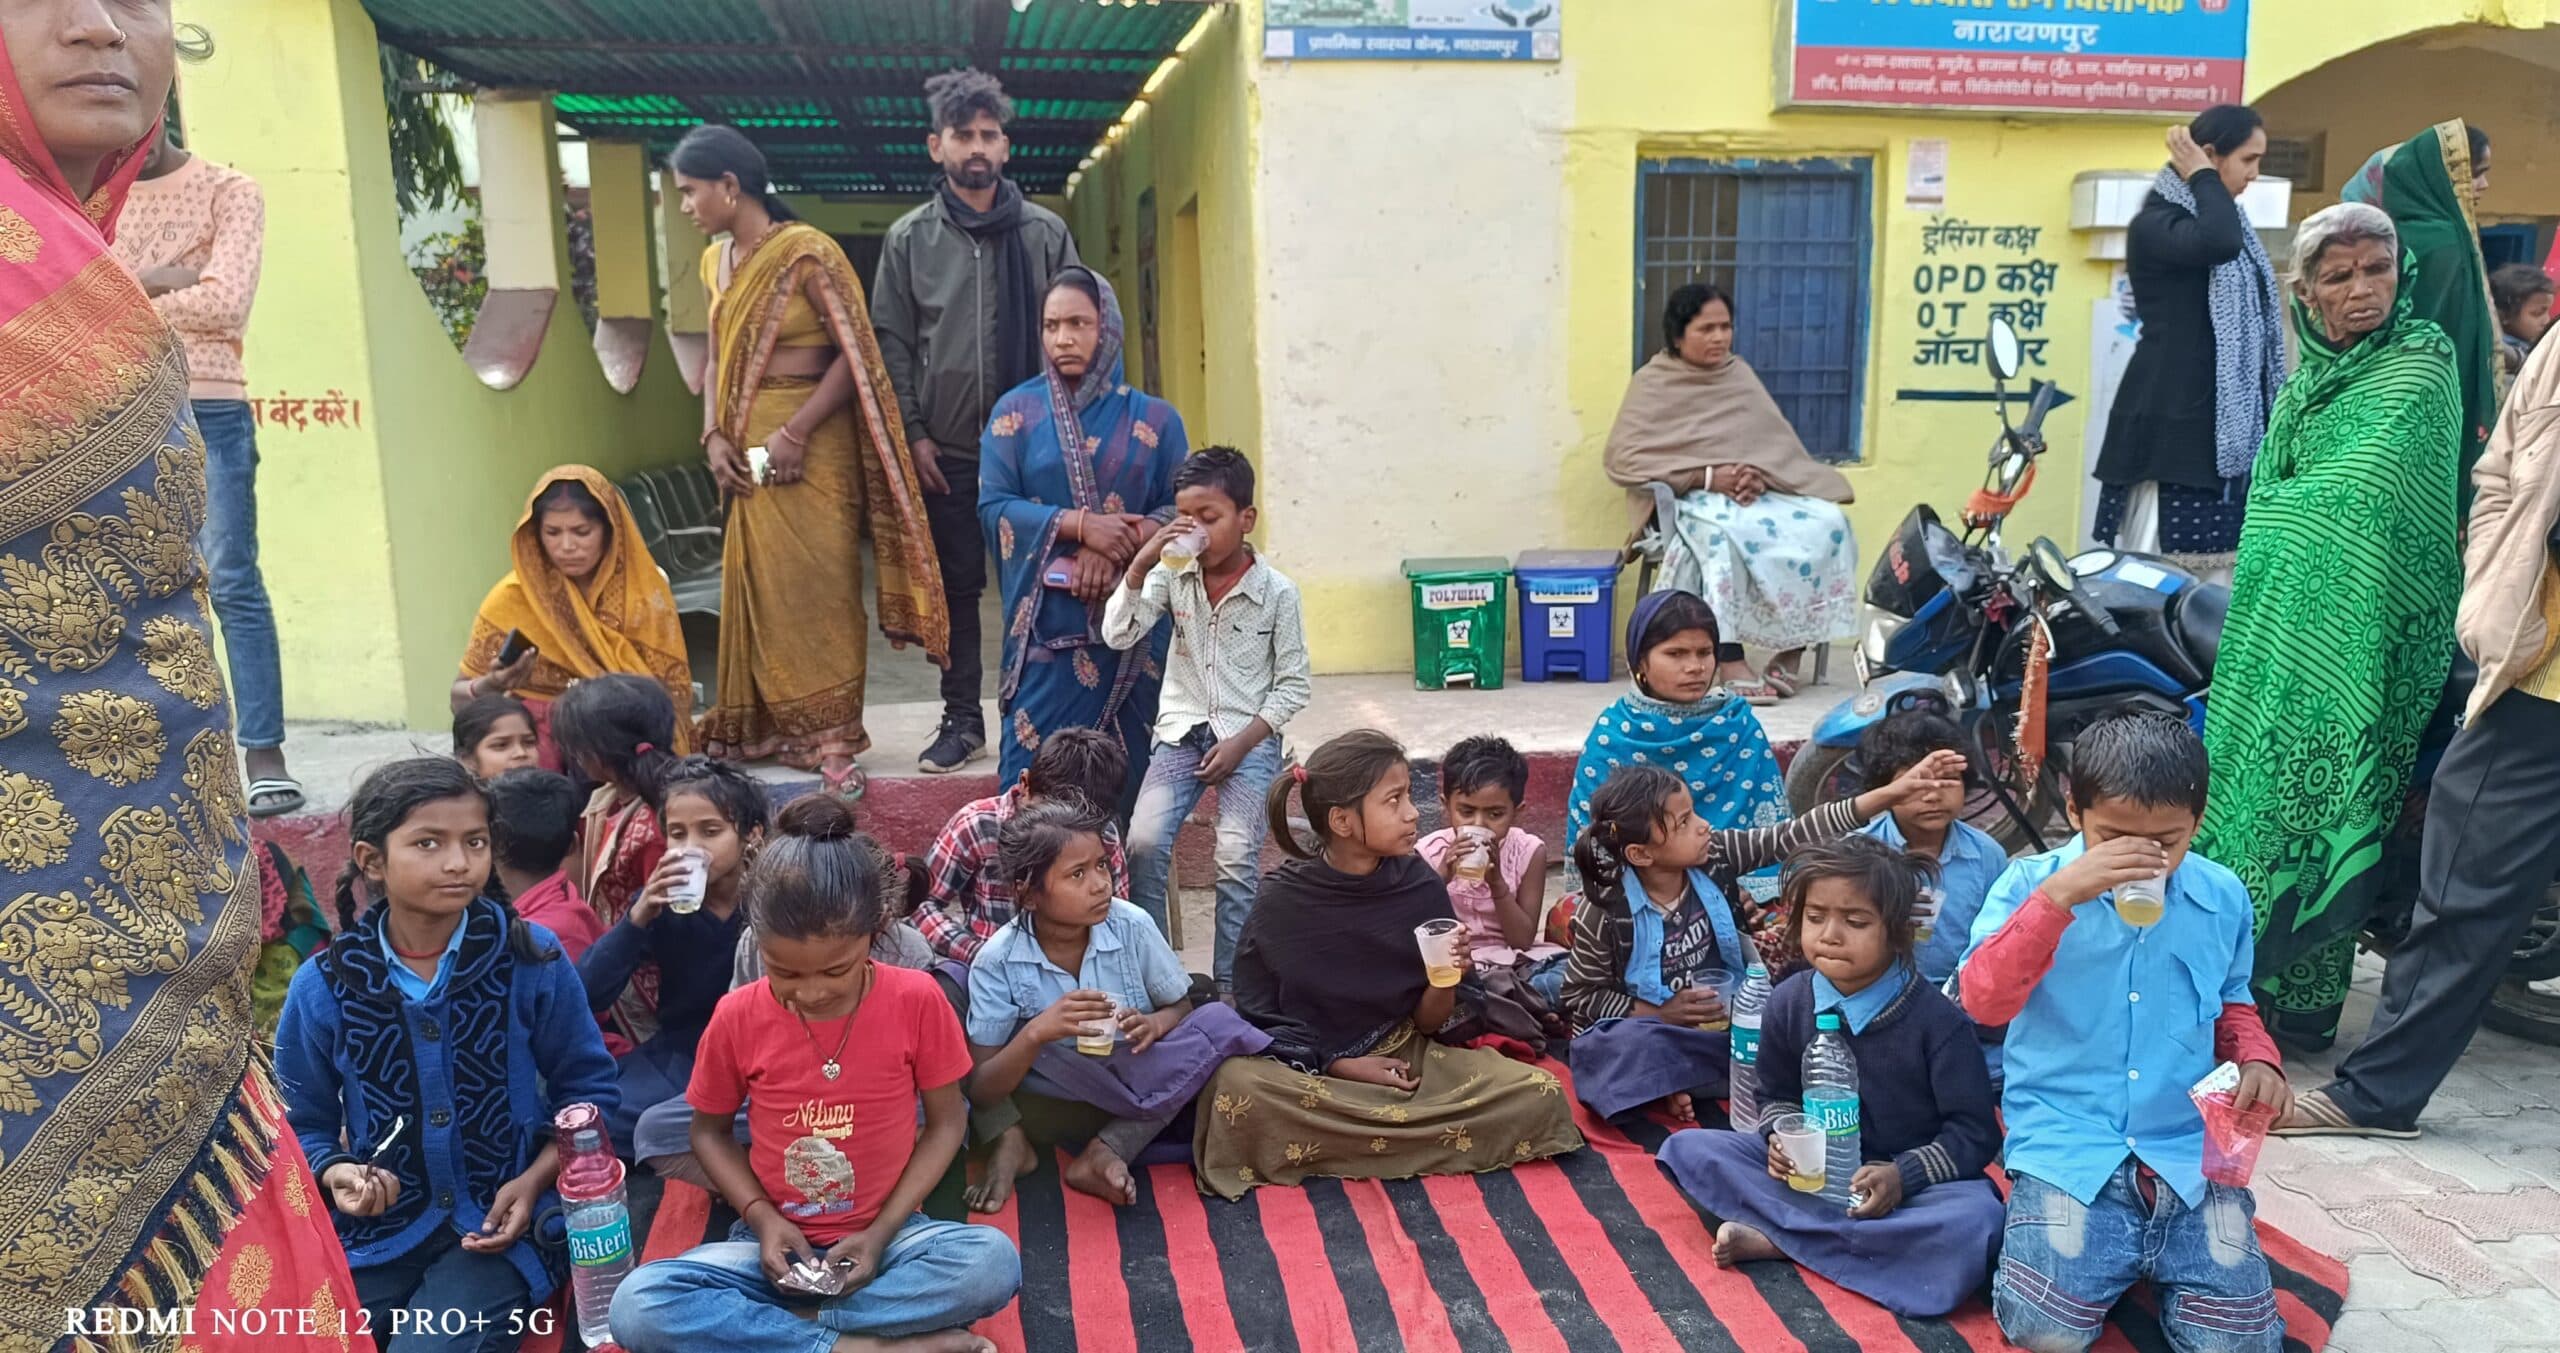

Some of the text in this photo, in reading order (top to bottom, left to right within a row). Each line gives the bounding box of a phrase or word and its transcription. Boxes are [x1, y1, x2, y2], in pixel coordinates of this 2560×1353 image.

[1952, 19, 2099, 53] नारायणपुर
[1992, 226, 2041, 254] कक्ष
[1913, 259, 2058, 295] OPD कक्ष
[269, 389, 309, 432] बंद
[1430, 589, 1487, 602] POLYWELL
